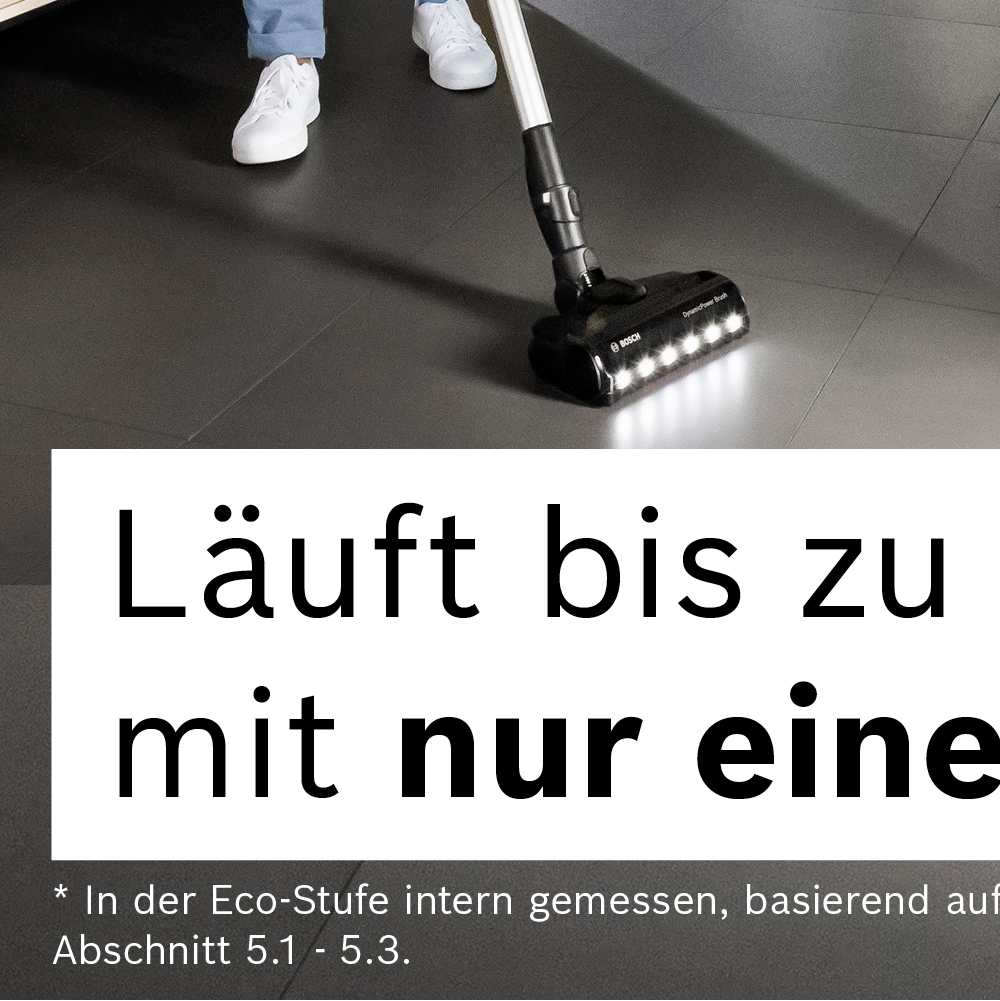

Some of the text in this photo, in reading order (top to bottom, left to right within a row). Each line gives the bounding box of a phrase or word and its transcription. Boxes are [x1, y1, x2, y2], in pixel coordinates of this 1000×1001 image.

[682, 291, 728, 317] DynamicPower Brush
[619, 331, 641, 348] BOSCH
